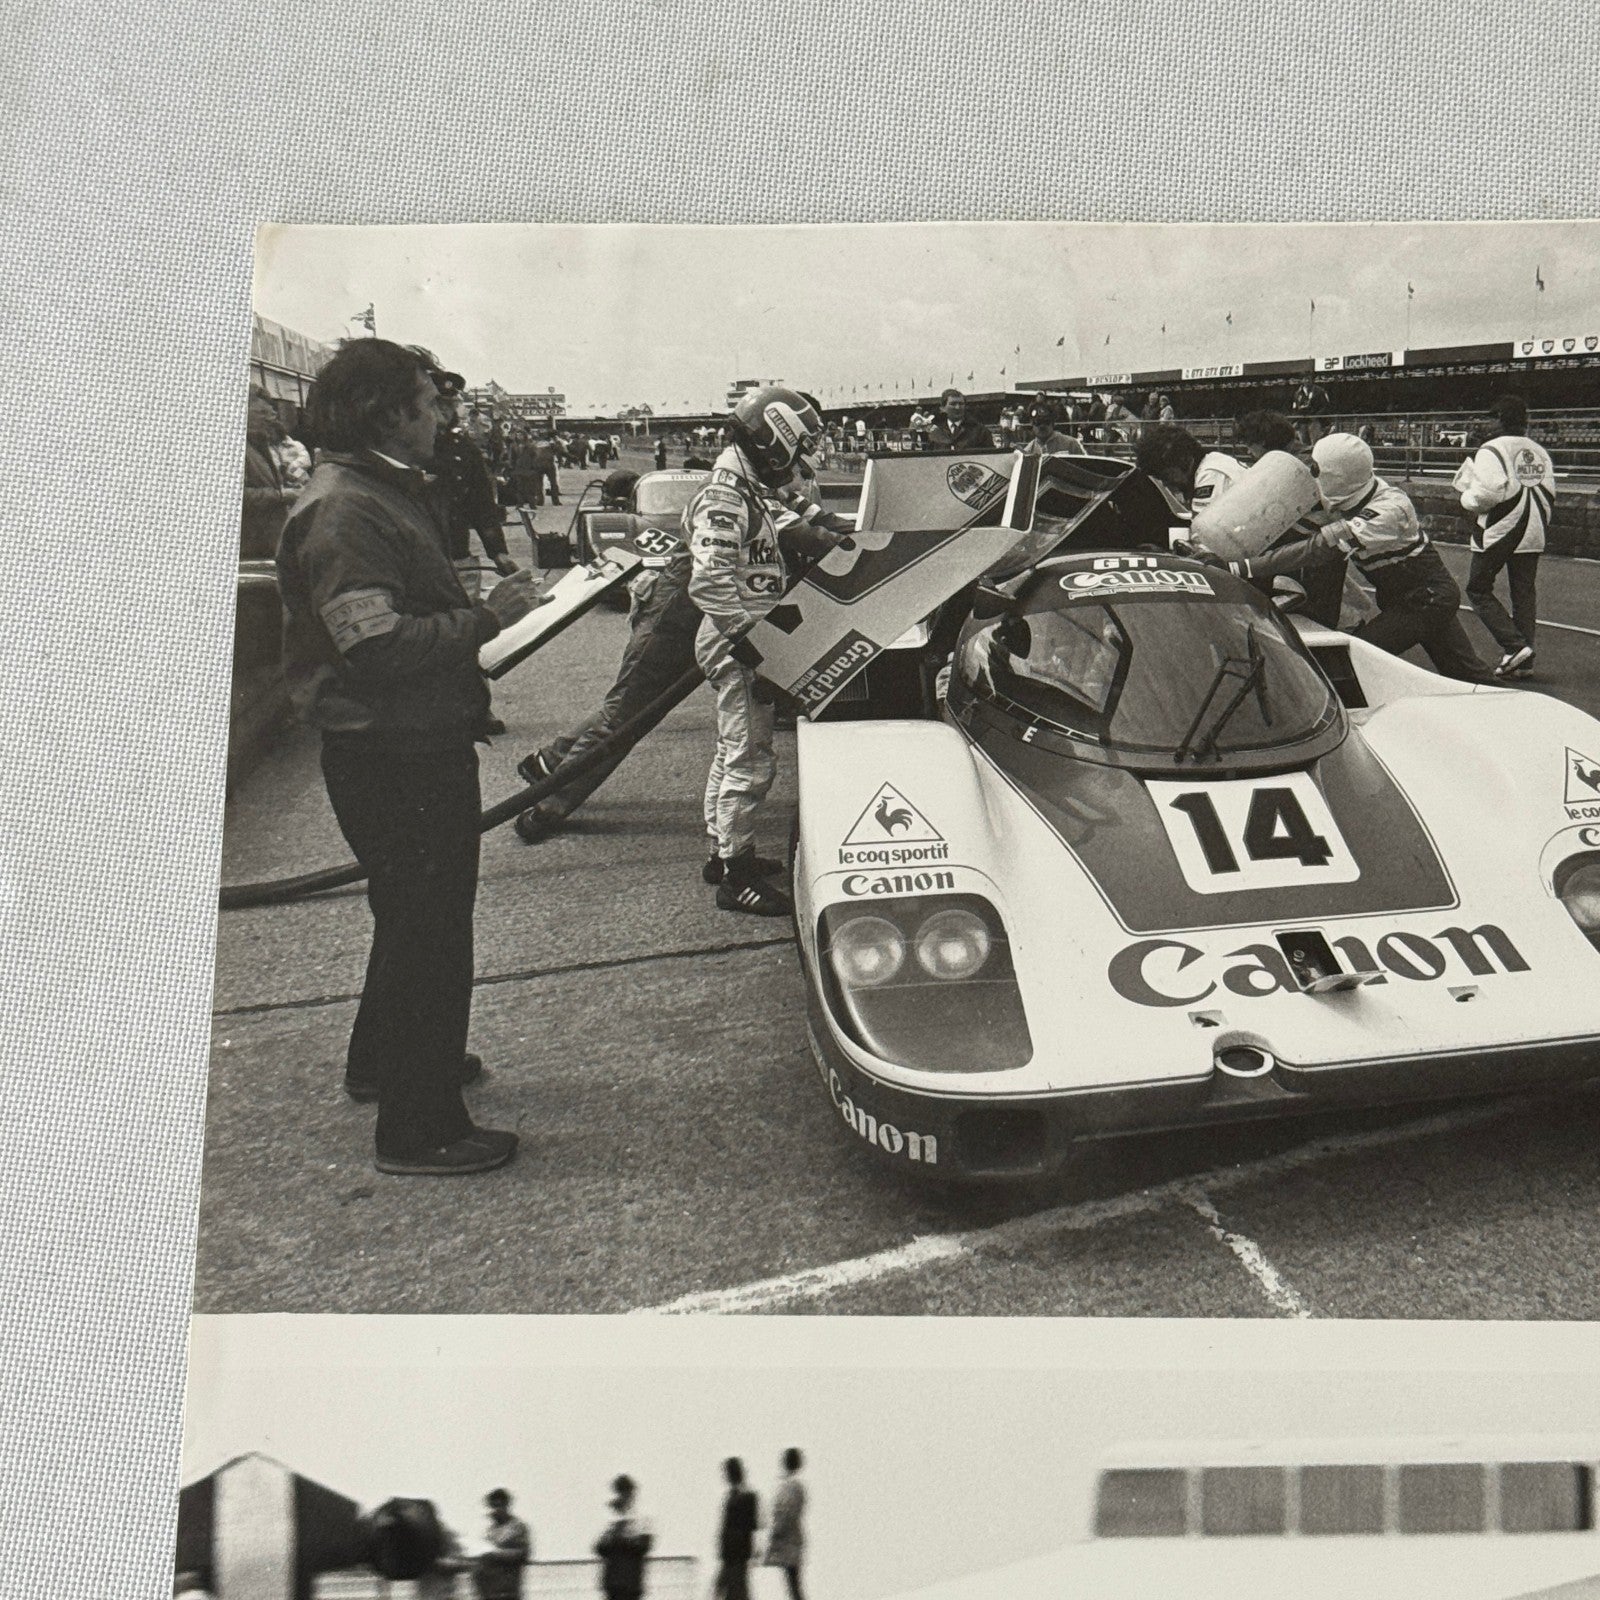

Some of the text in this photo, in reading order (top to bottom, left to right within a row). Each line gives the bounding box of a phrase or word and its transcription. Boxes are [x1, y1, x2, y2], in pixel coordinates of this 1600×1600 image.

[1345, 354, 1389, 369] Lockheed
[635, 529, 678, 554] 35
[701, 537, 739, 550] Canon
[1093, 557, 1158, 570] GTI
[1059, 569, 1211, 592] Canon
[1168, 787, 1334, 875] 14
[839, 843, 949, 865] le coq sportif
[842, 871, 955, 897] Canon
[829, 1067, 937, 1165] Canon
